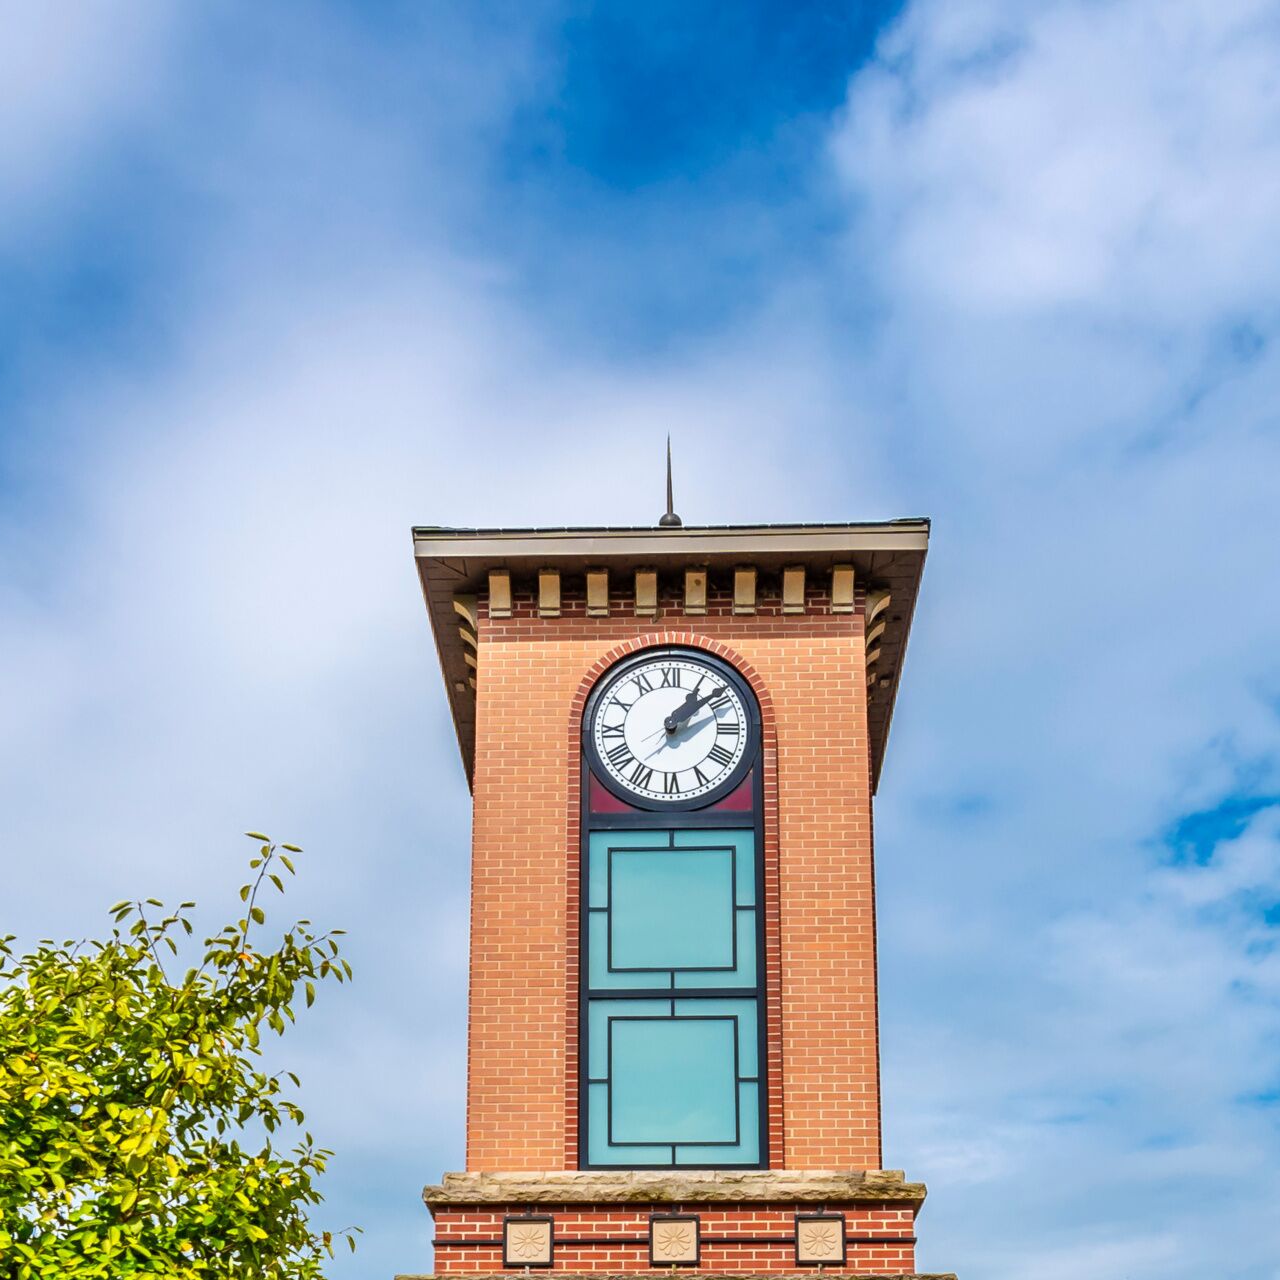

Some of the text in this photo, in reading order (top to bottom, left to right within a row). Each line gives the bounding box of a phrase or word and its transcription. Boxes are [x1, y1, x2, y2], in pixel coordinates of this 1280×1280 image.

[631, 673, 654, 696] XI
[660, 667, 681, 688] XII
[608, 696, 632, 713] X
[709, 695, 731, 710] II
[601, 723, 625, 739] IX
[717, 722, 740, 735] III
[606, 742, 635, 773] VIII
[629, 762, 654, 790] VII
[663, 771, 681, 794] VI
[693, 765, 710, 788] V
